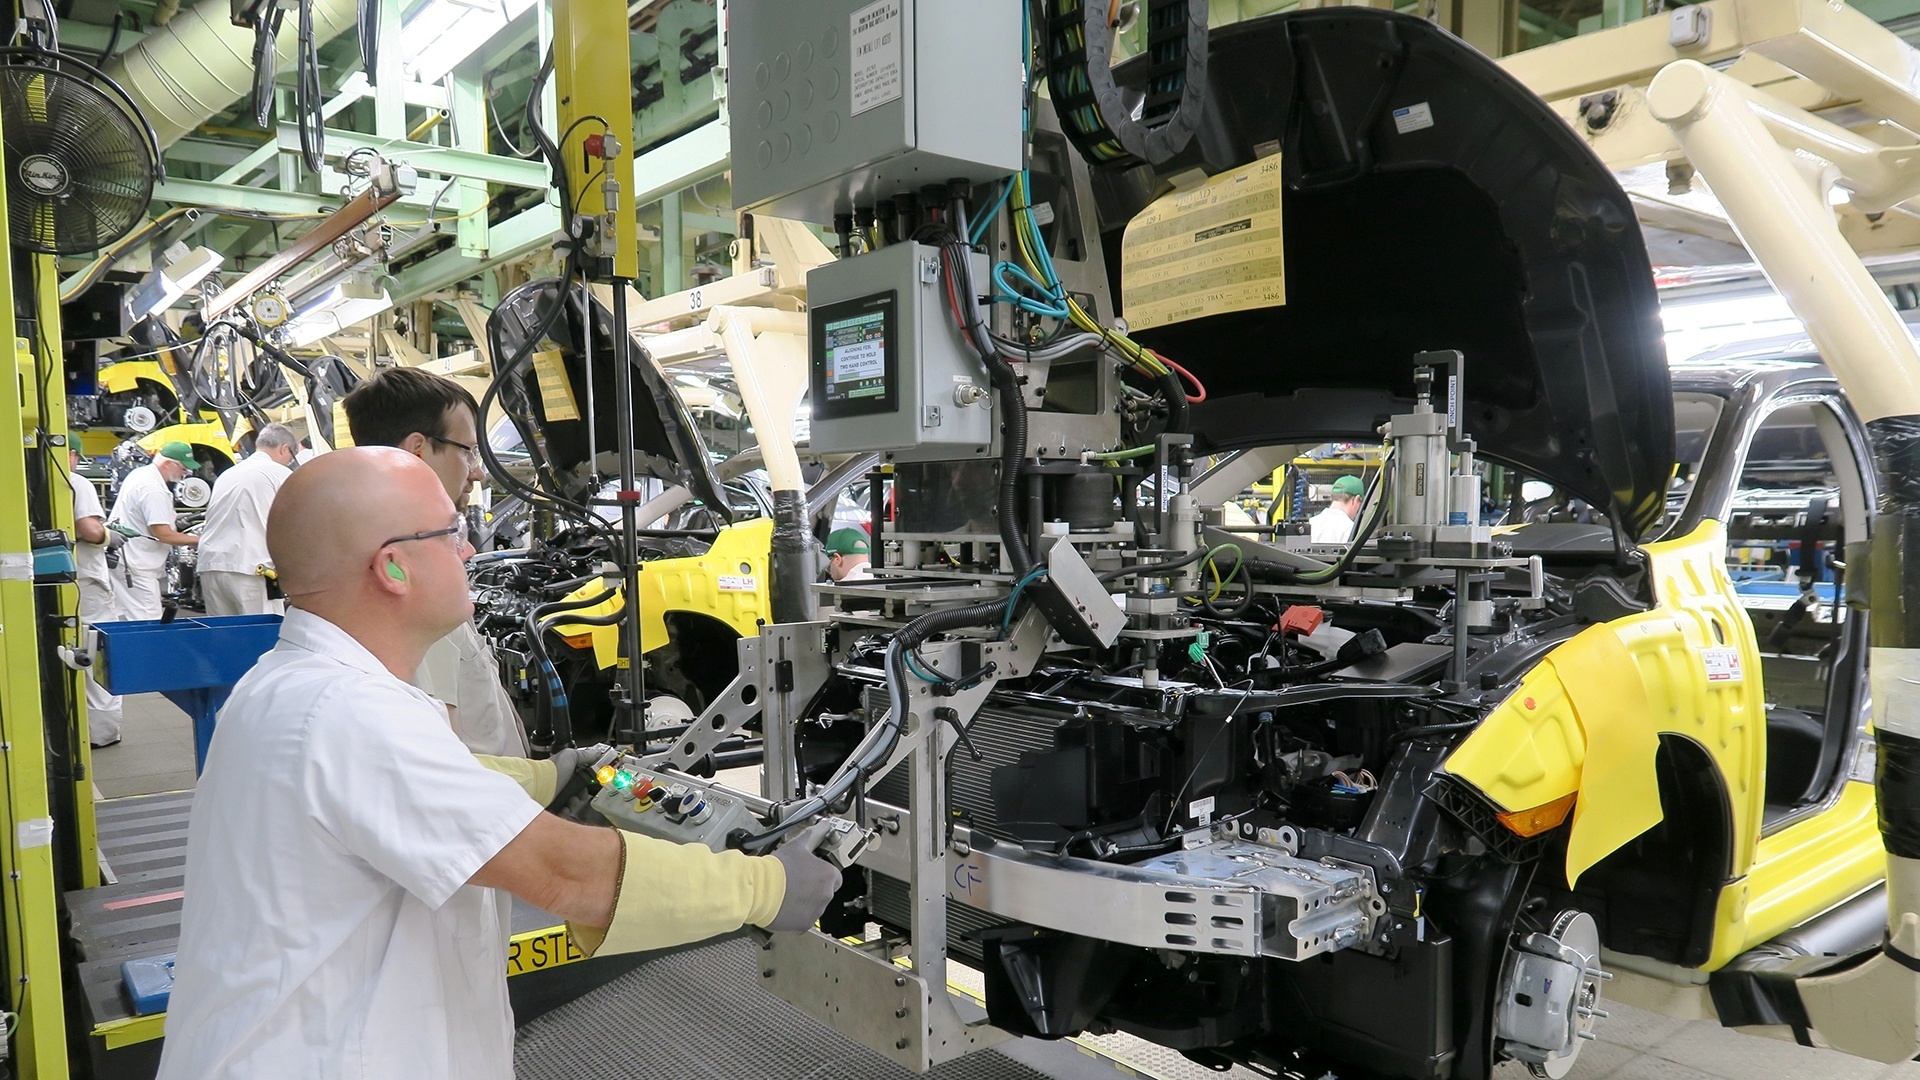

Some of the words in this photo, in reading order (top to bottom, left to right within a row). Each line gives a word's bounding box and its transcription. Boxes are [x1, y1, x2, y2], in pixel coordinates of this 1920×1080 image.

[1260, 161, 1278, 175] 3486
[690, 291, 702, 310] 38
[1262, 293, 1280, 302] 3486
[844, 346, 862, 354] ALIGNING
[840, 354, 860, 362] CONTINUE
[860, 359, 878, 367] CONTROL
[1727, 653, 1740, 668] LH
[954, 863, 982, 897] CF
